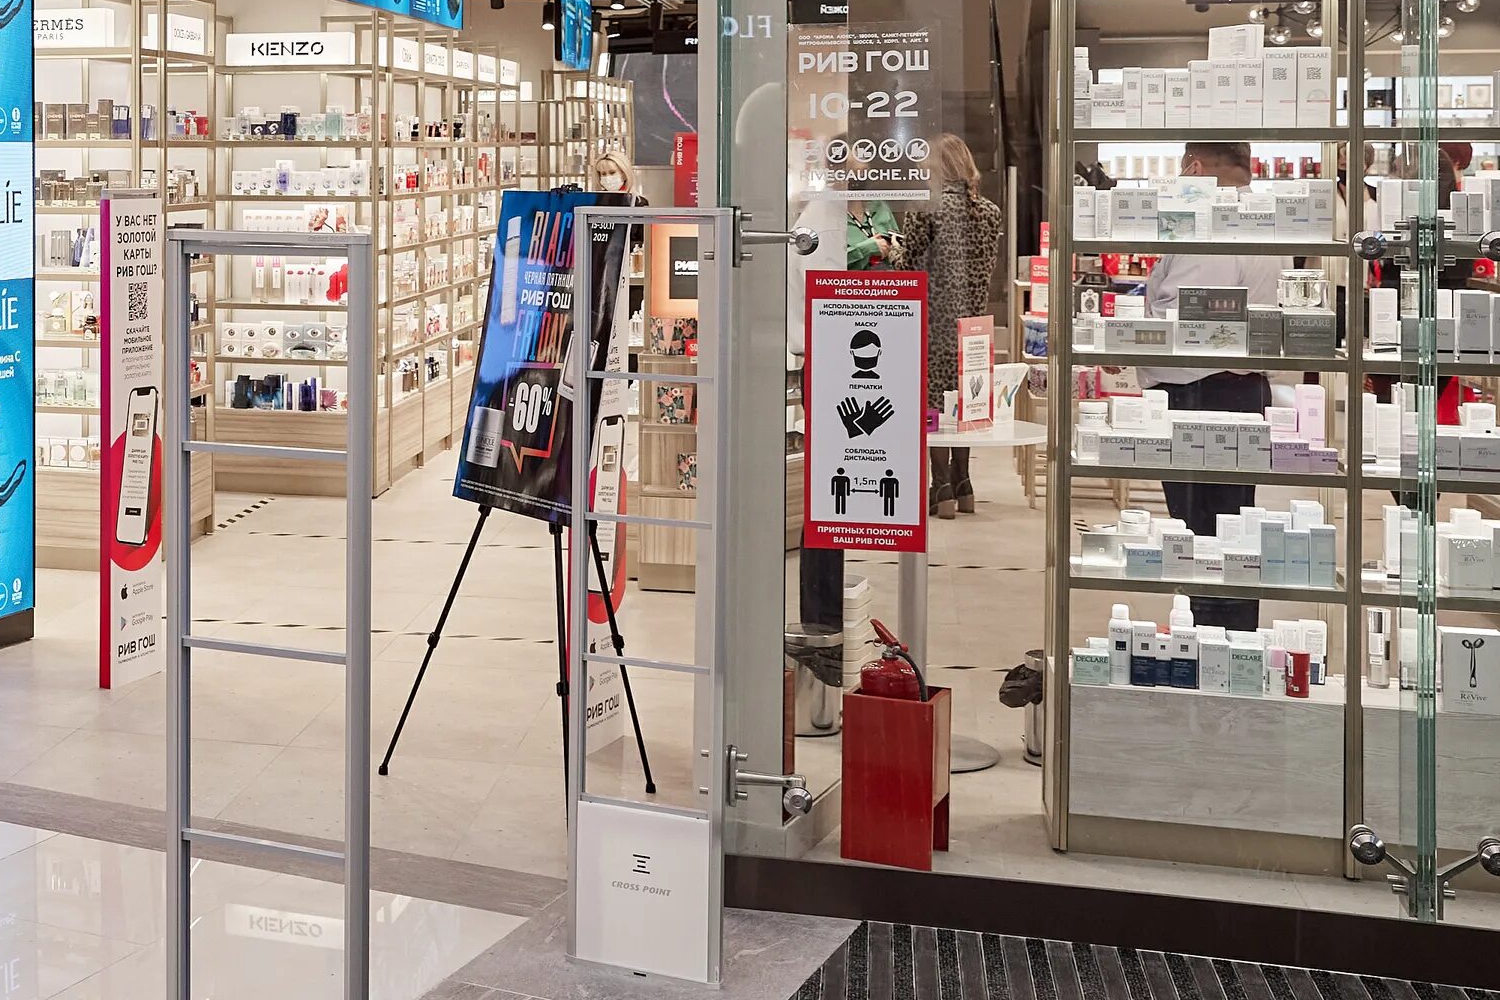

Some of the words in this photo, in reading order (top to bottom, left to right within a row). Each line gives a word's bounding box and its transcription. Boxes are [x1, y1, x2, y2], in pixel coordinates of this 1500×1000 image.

[33, 18, 84, 31] ERMÈS
[37, 33, 64, 41] PARIS
[251, 41, 324, 57] KENZO
[798, 51, 858, 73] РИВ
[866, 50, 930, 72] ГОШ
[809, 91, 919, 120] 10-22
[115, 215, 122, 227] У
[124, 214, 141, 227] ВАС
[142, 214, 157, 226] НЕТ
[117, 228, 157, 244] ЗОЛОТОЙ
[592, 232, 608, 243] 2021
[123, 249, 152, 261] КАРТЫ
[116, 265, 134, 278] РИВ
[135, 264, 158, 277] ГОШ?
[815, 278, 863, 286] НАХОДЯСЬ
[871, 279, 919, 287] МАГАЗИНЕ
[834, 288, 899, 297] НЕОБХОДИМО
[521, 289, 545, 307] РИВ
[545, 291, 572, 310] ГОШ
[819, 309, 884, 317] ИНДИВИДУАЛЬНОЙ
[884, 310, 914, 318] ЗАЩИТЫ
[125, 325, 150, 334] СКАЧАЙТЕ
[123, 334, 152, 345] МОБИЛЬНОЕ
[512, 309, 568, 364] FRIDAY
[121, 344, 153, 354] ПРИЛОЖЕНИЕ
[849, 383, 883, 391] ПЕРЧАТКИ
[844, 447, 887, 456] СОБЛЮДАТЬ
[843, 454, 887, 463] ДИСТАНЦИЮ
[817, 525, 865, 536] ПРИЯТНЫХ
[866, 527, 913, 537] ПОКУПОК!
[832, 536, 854, 545] ВАШ
[855, 537, 873, 545] РИВ
[873, 538, 897, 546] ГОШ.
[118, 638, 137, 658] РИВ
[137, 632, 156, 651] ГОШ
[586, 702, 604, 721] РИВ
[604, 693, 620, 714] ГОШ
[611, 880, 640, 893] CROSS
[642, 884, 672, 897] POINT
